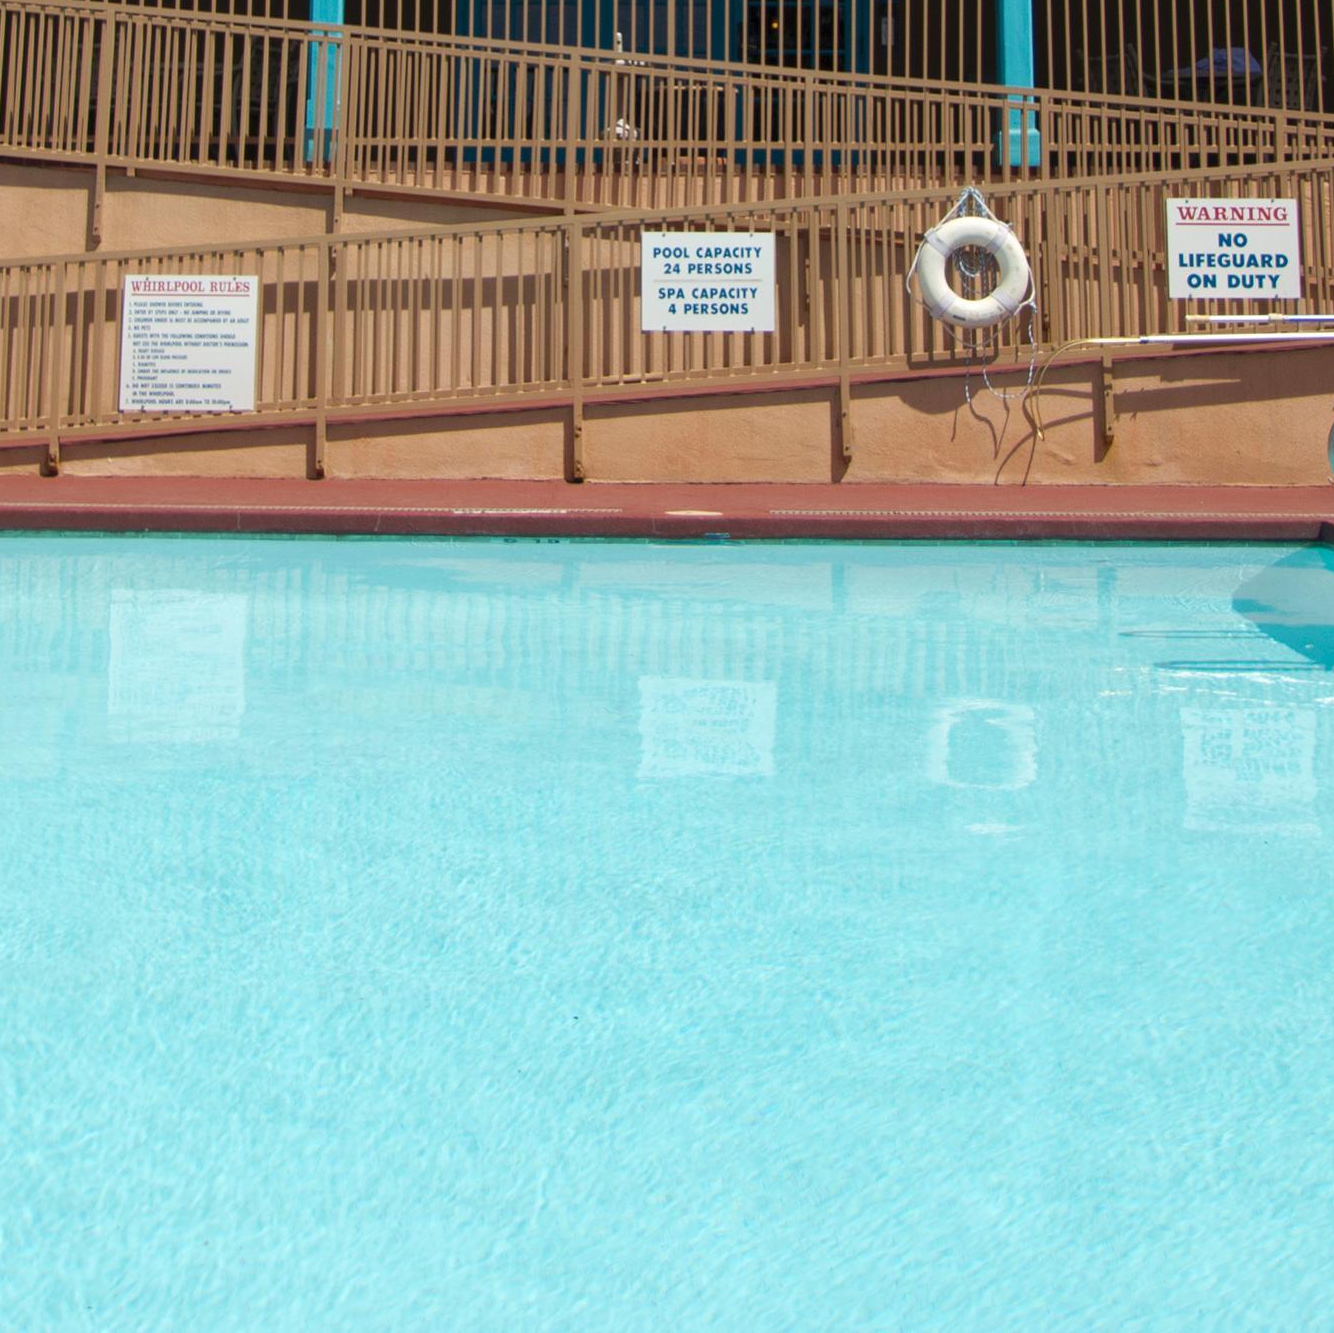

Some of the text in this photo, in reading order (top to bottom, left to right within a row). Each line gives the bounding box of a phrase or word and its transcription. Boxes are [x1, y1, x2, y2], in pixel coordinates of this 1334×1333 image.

[1177, 207, 1288, 221] WARNING
[1218, 233, 1247, 247] NO
[653, 247, 762, 258] POOL CAPACITY
[1179, 254, 1288, 268] LIFEGUARD
[664, 263, 752, 274] 24 PERSONS
[131, 281, 250, 292] WHIRLPOOL RULES
[1187, 274, 1280, 288] ON DUTY
[658, 288, 758, 299] SPA CAPACITY
[668, 303, 748, 314] 4 PERSONS
